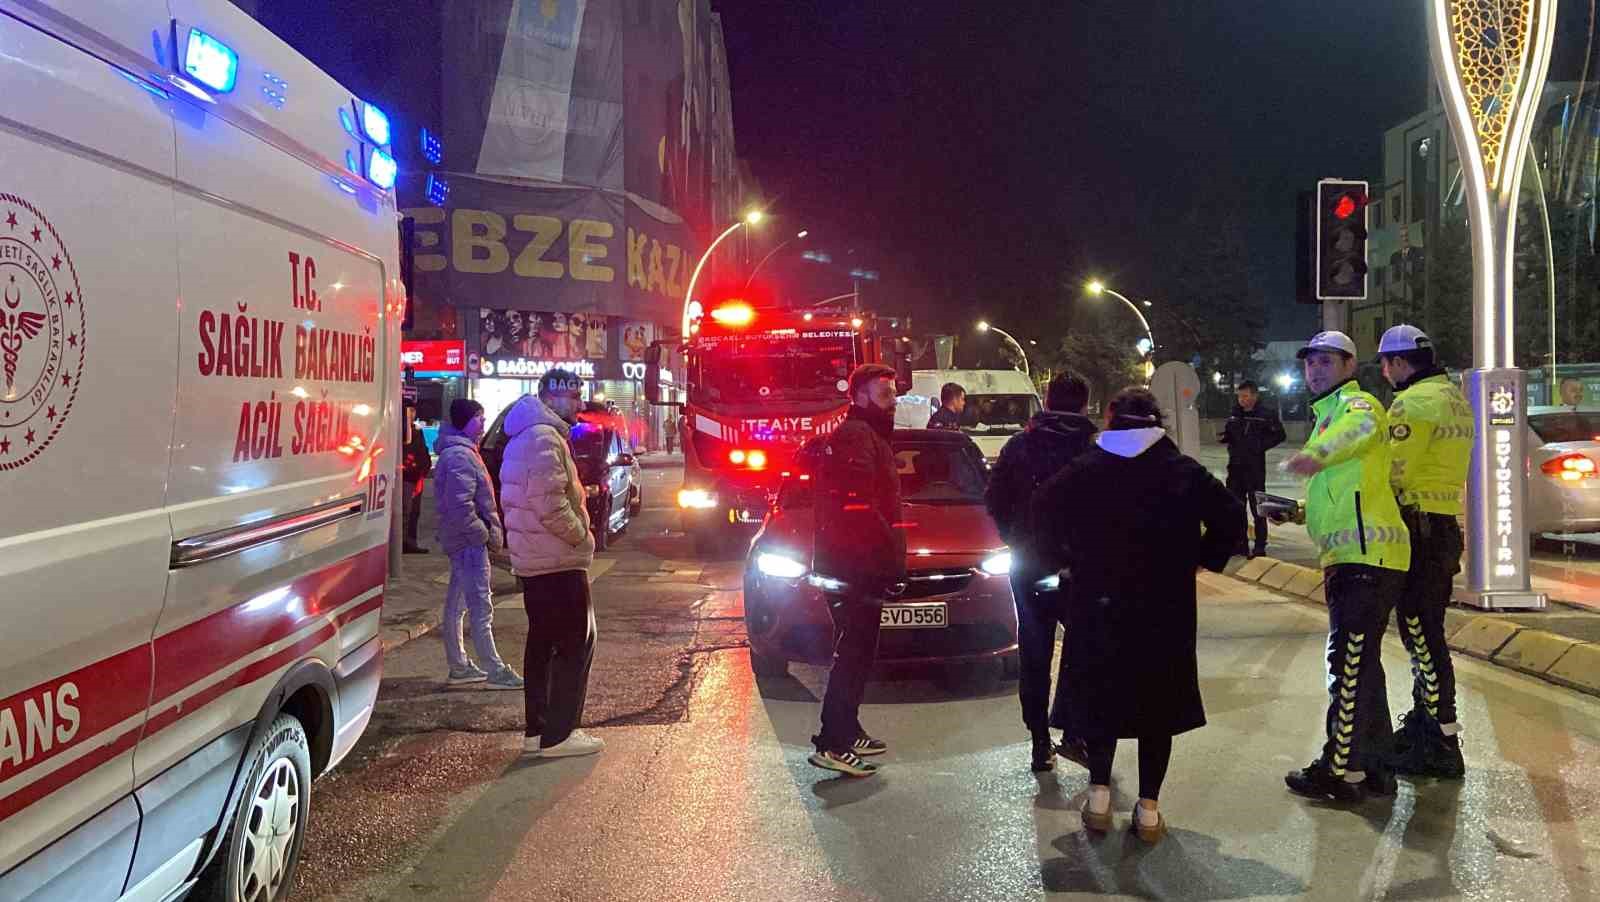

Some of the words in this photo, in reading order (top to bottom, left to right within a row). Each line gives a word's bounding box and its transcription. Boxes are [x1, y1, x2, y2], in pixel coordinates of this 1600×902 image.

[25, 254, 56, 307] SAĞLIK
[288, 250, 322, 312] T.C.
[31, 314, 60, 406] BAKANLIĞI
[199, 301, 284, 379] SAĞLIK
[295, 325, 375, 382] BAKANLIĞI
[232, 390, 283, 463] ACİL
[0, 681, 80, 768] ANS
